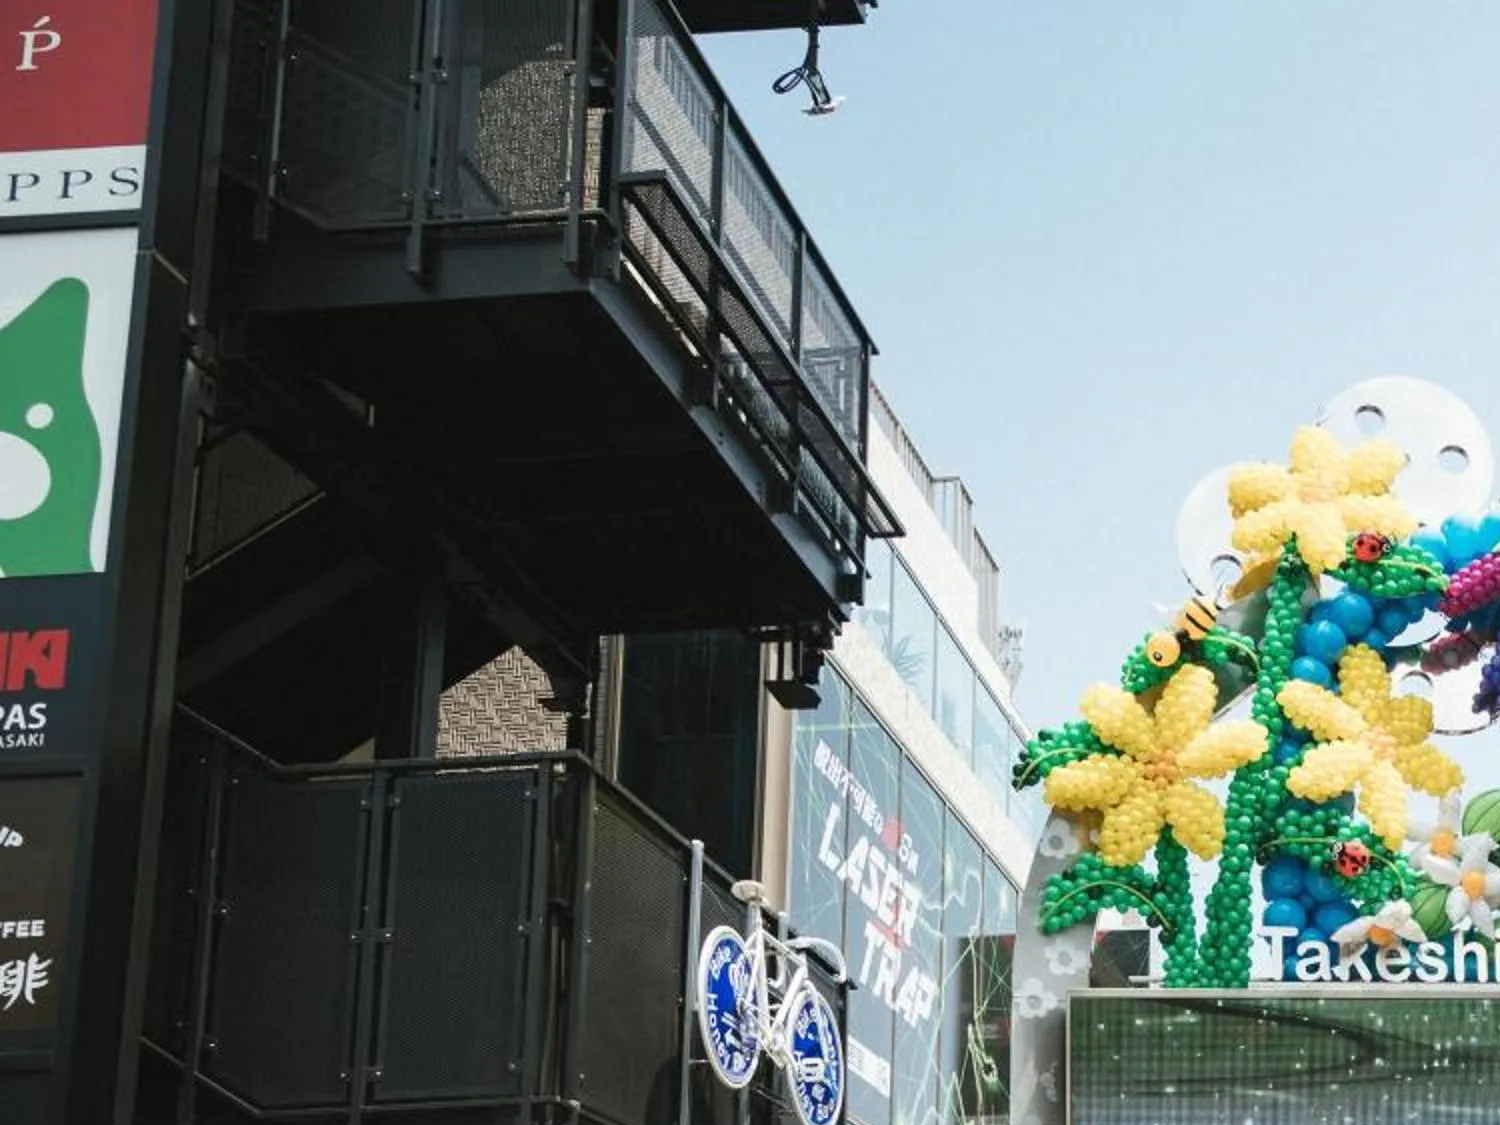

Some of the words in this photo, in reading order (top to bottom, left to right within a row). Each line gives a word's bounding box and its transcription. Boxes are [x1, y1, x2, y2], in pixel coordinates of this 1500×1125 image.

[0, 919, 46, 939] FEE
[817, 802, 925, 947] LASER
[857, 920, 940, 1029] TRAP
